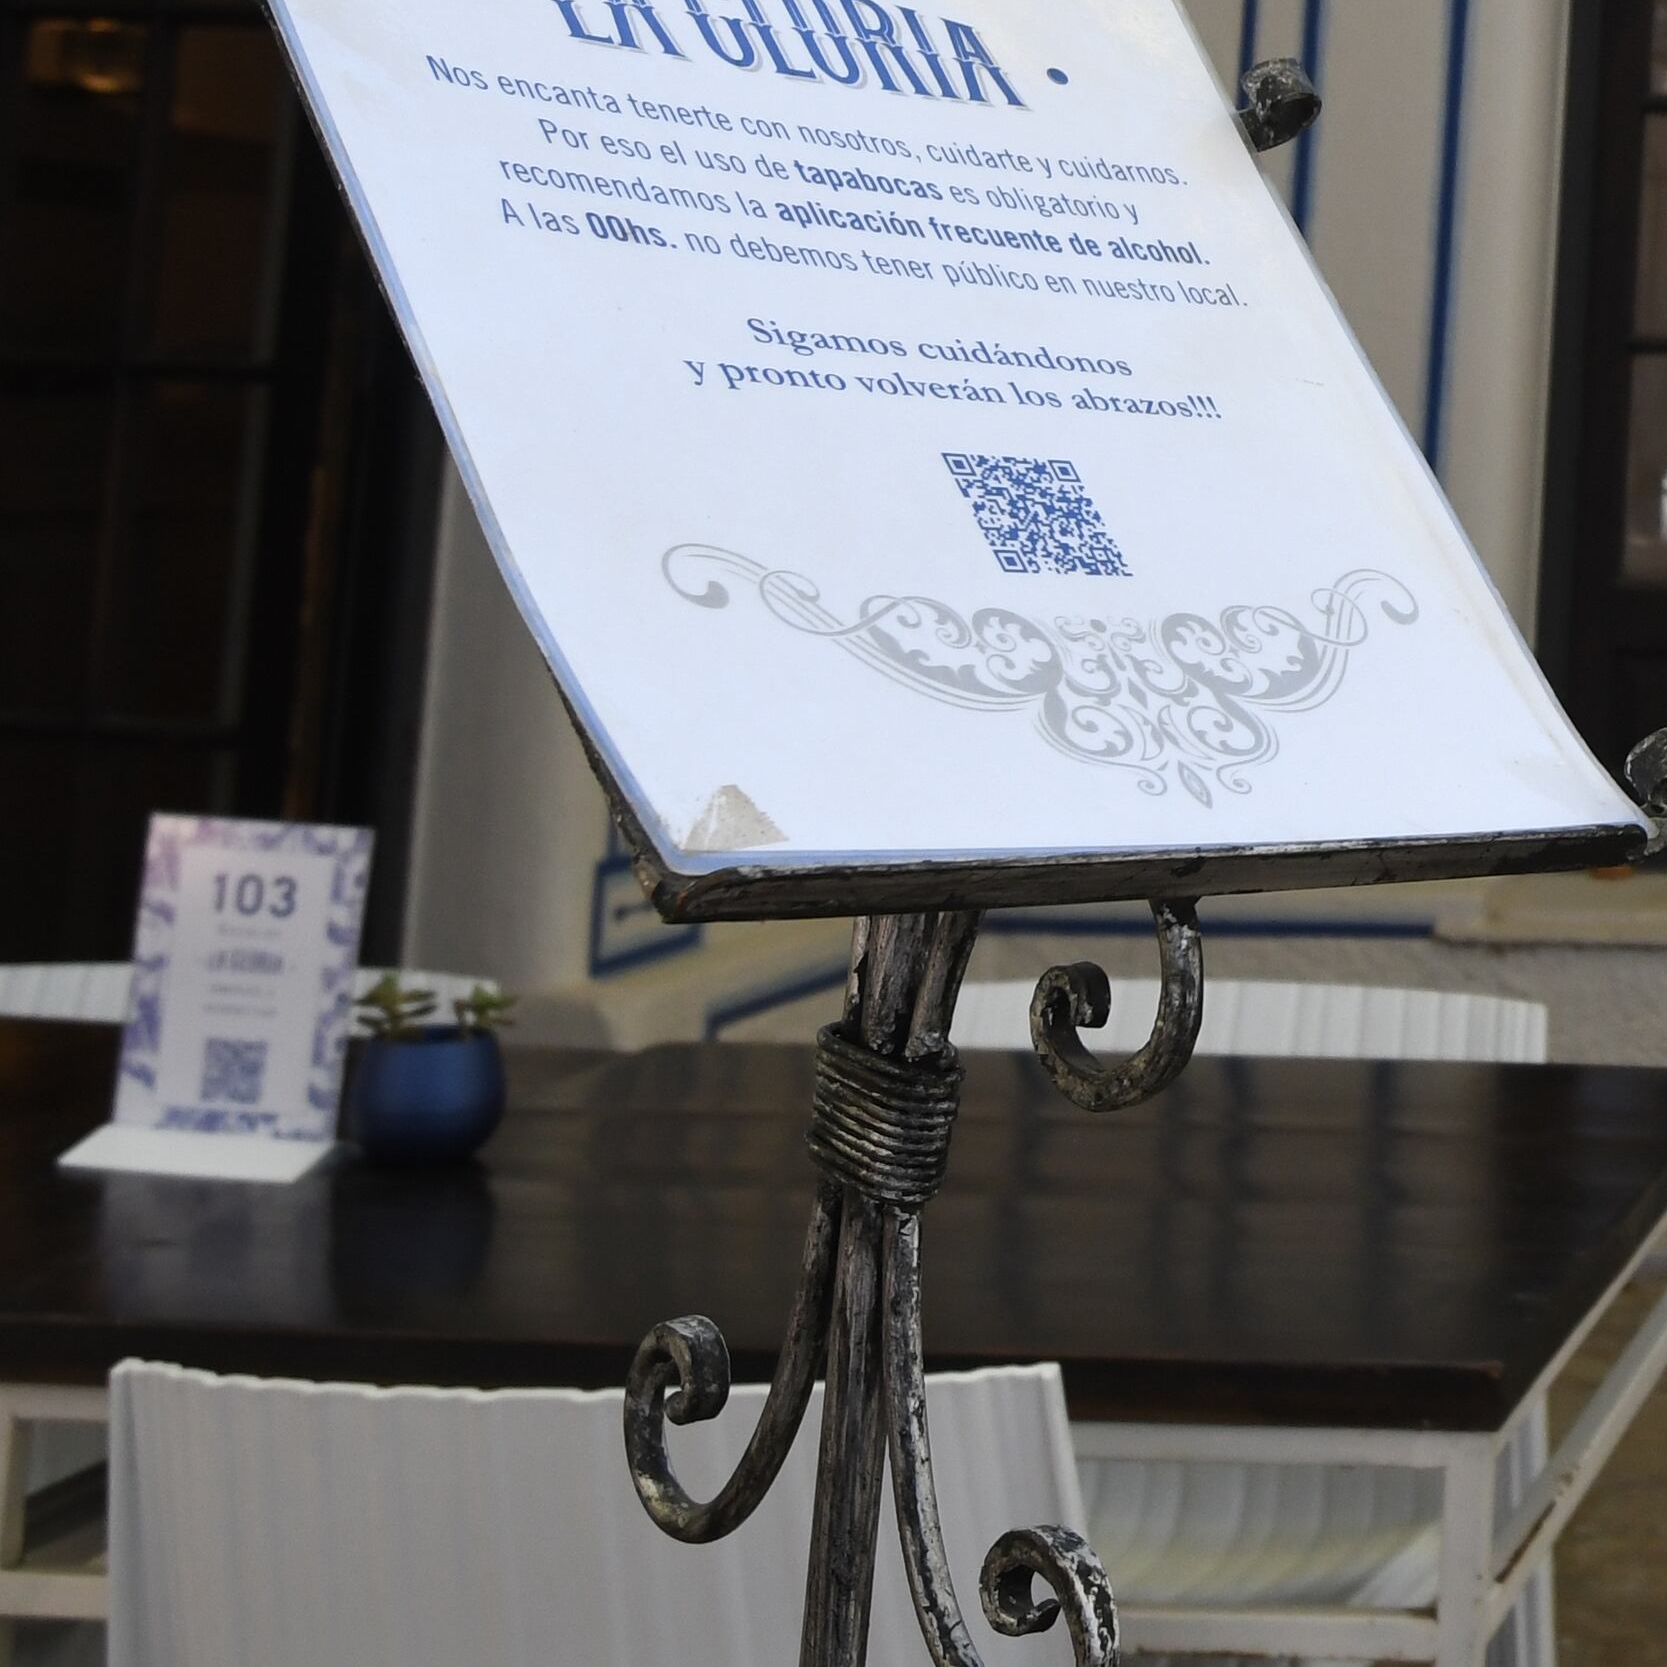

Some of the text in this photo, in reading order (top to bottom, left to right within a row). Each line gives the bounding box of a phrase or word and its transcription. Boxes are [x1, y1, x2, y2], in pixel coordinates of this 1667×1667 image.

[425, 54, 1188, 186] Nos encanta tenerte con nosotros, cuidarte y cuidarnos.
[537, 117, 1139, 226] Por eso el uso de tapabocas es obligatorio y
[498, 159, 1211, 266] recomendamos la aplicación frecuente de alcohol.
[500, 197, 1248, 307] A las 00hs. no debemos tener público en nuestro local.
[682, 359, 1222, 419] y pronto volverán los abrazos!!!
[746, 317, 1133, 377] Sigamos cuidándonos
[214, 872, 298, 919] 103
